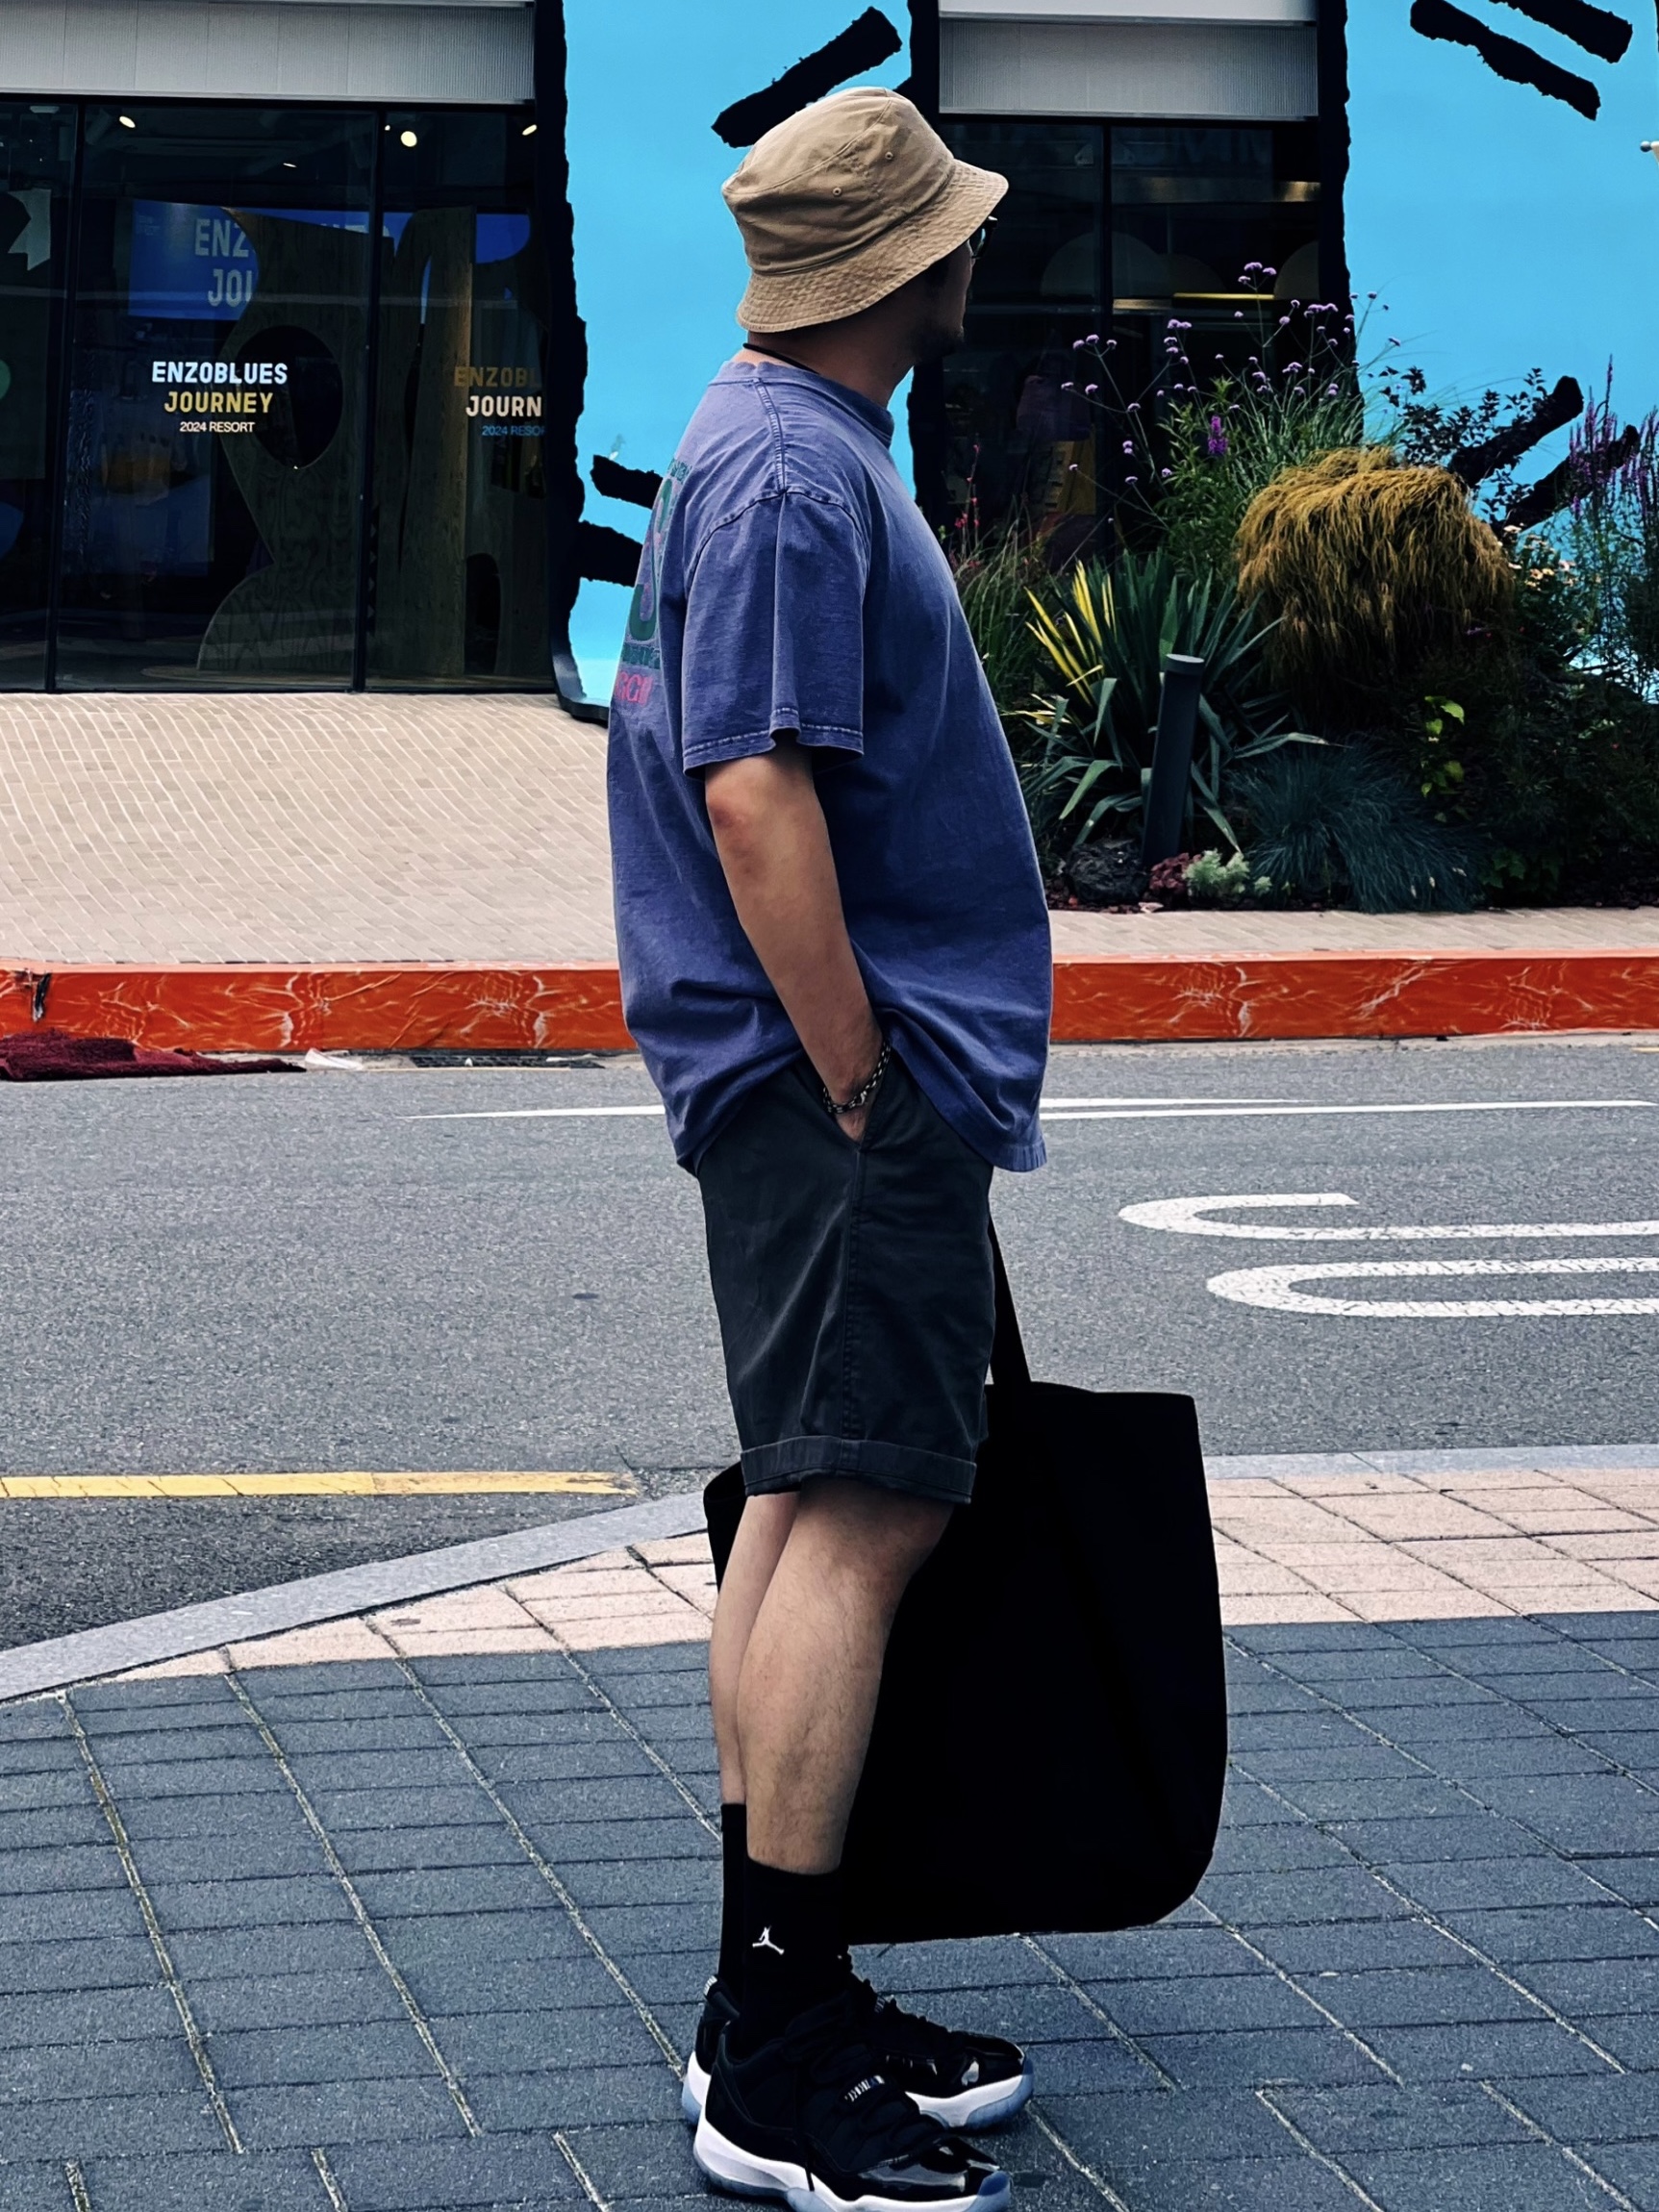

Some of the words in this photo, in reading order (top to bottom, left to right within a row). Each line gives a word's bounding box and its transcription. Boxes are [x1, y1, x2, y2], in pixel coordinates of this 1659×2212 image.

[195, 218, 252, 258] ENZ
[152, 361, 288, 384] ENZOBLUES
[164, 391, 273, 414] JOURNEY
[465, 394, 542, 417] JOURN
[179, 421, 207, 432] 2024
[209, 421, 255, 433] RESORT
[482, 425, 508, 436] 2024
